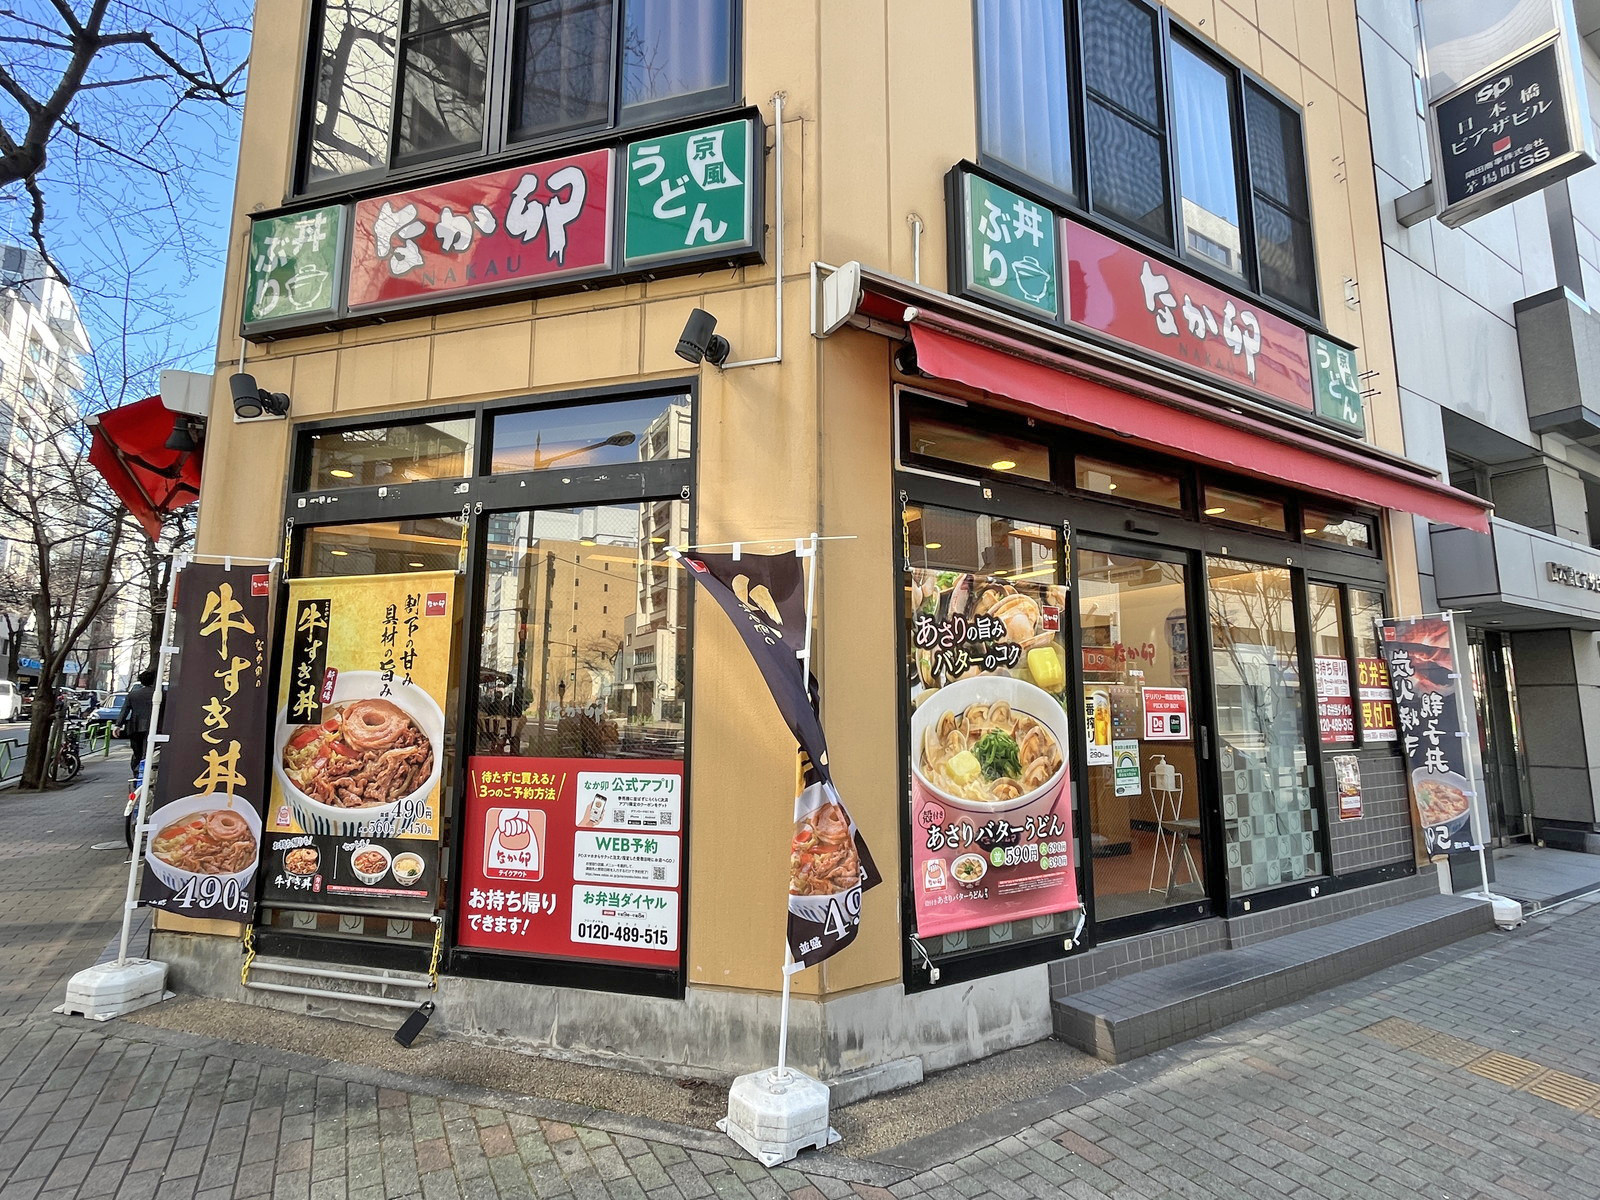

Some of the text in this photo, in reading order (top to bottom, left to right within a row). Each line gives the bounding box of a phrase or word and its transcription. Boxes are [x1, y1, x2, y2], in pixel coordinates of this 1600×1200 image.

[1451, 101, 1553, 156] ピアザビル
[692, 133, 727, 187] 京風
[630, 147, 728, 246] うどん
[374, 165, 587, 275] なか卯
[420, 255, 523, 288] NAKAU
[1140, 261, 1260, 384] なか卯
[1316, 341, 1358, 424] うどん
[400, 593, 421, 686] 割下の甘み
[915, 614, 1005, 647] あさりの旨み
[293, 603, 328, 721] 牛すき丼
[380, 604, 399, 697] 具材の旨み
[933, 644, 1021, 676] バターのコク
[1359, 662, 1389, 686] お弁当
[193, 582, 256, 807] 牛すき丼
[1085, 696, 1095, 743] 一番搾り
[1319, 718, 1354, 732] 120-489-515
[1362, 702, 1394, 728] 受付口
[481, 770, 556, 785] 待たずに買える!
[611, 777, 675, 794] 公式アプリ
[479, 785, 556, 800] 3つのご予約方法
[391, 799, 432, 819] 490円
[922, 810, 944, 825] 殻付き
[595, 837, 658, 854] WEB予約
[926, 815, 1065, 851] あさりバターうどん
[496, 850, 531, 867] なか卯
[1005, 845, 1039, 865] 590円
[274, 874, 312, 890] 牛すき丼
[498, 869, 527, 877] テイクアウト
[172, 876, 249, 914] 490円
[468, 887, 557, 916] お持ち帰り
[583, 891, 668, 910] お弁当ダイヤル
[467, 914, 530, 936] できます!
[578, 922, 668, 945] 0120-489-515
[799, 936, 823, 955] 並盛
